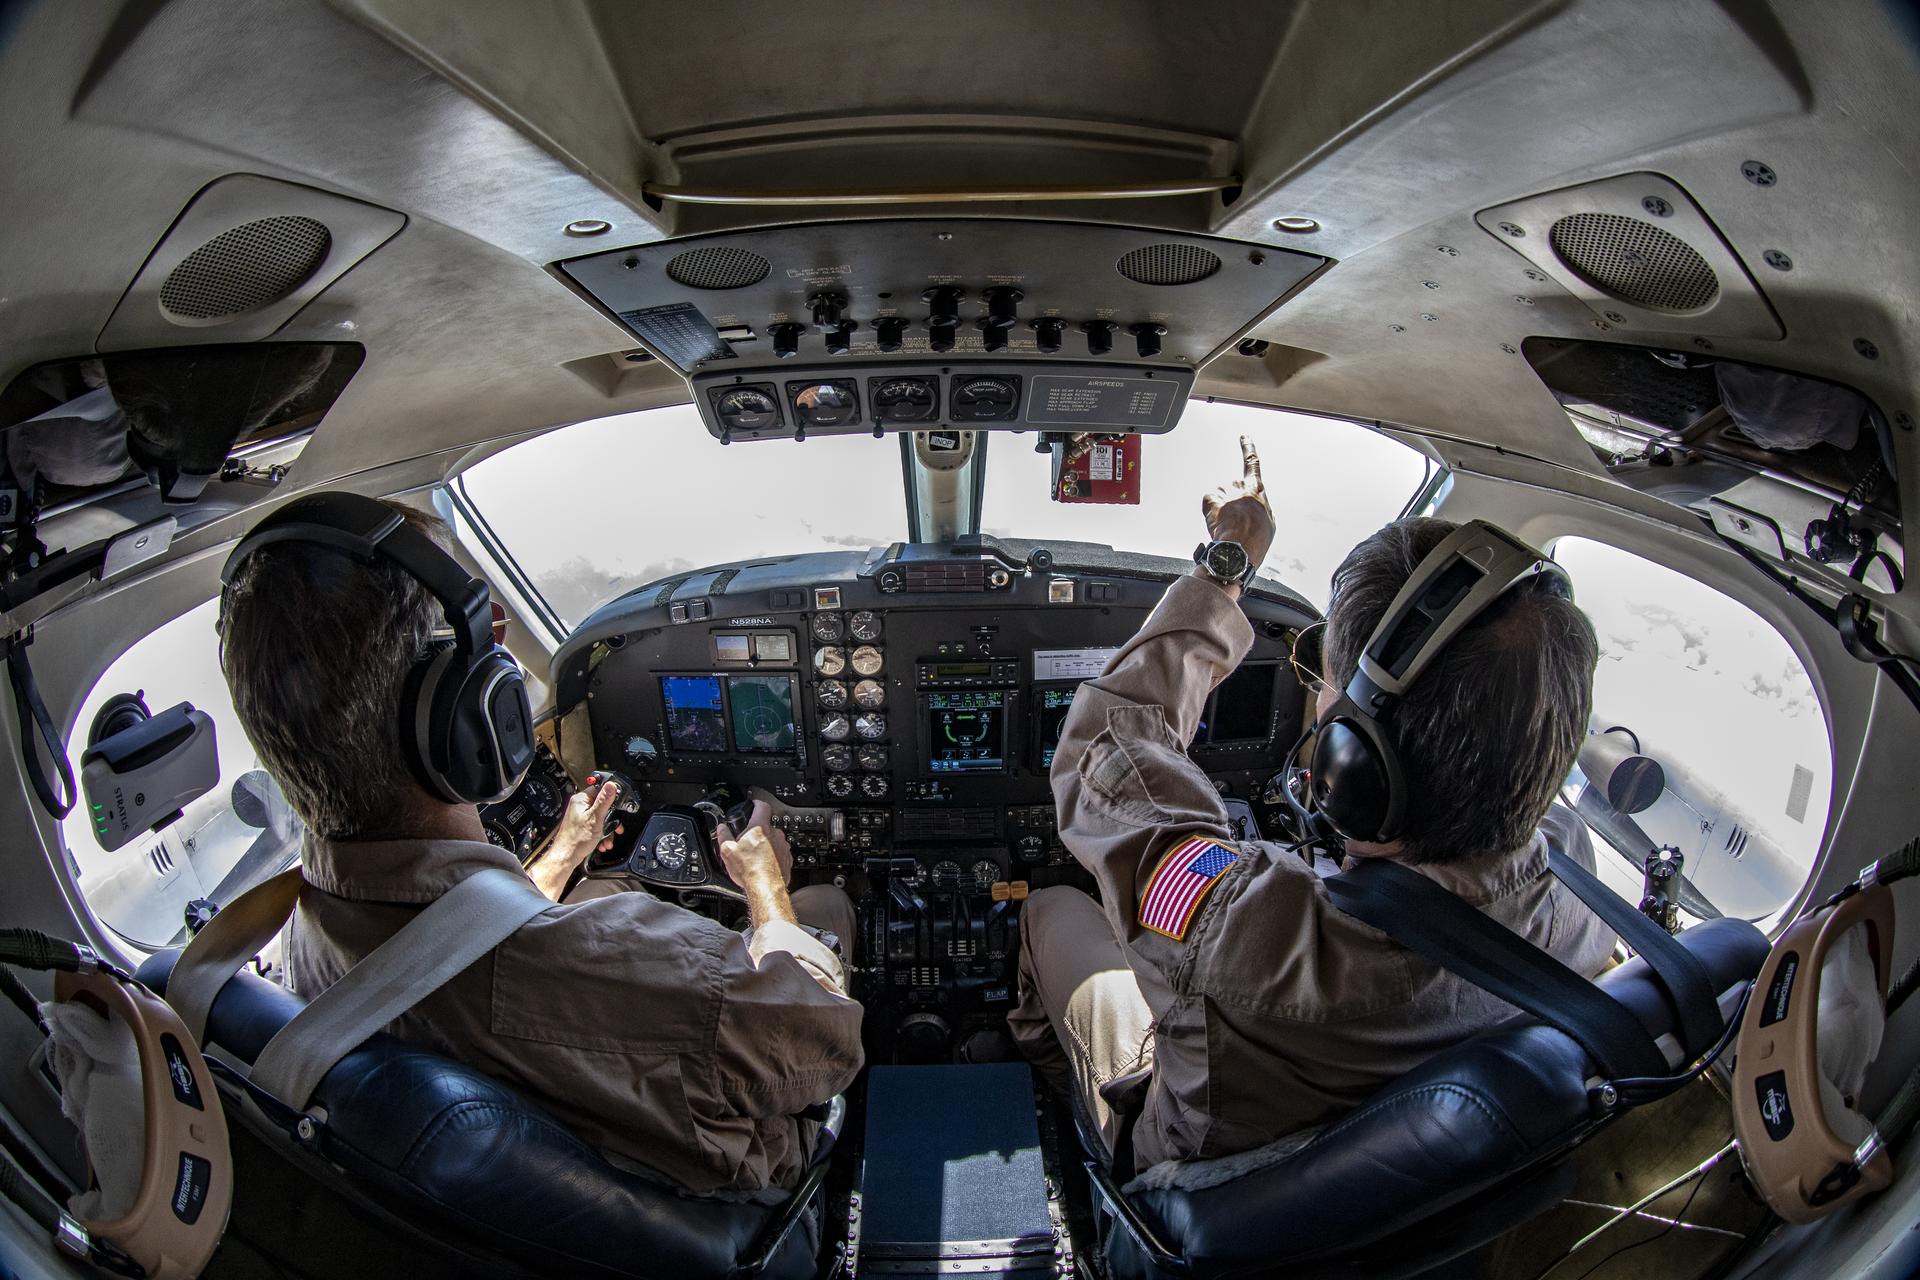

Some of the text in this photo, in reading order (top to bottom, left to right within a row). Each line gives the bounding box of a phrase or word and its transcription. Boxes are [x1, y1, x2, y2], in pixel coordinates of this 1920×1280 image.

[934, 437, 952, 447] INOP
[114, 787, 129, 830] STRATUS
[986, 990, 1006, 998] FLAP
[176, 1157, 193, 1212] INTERTECHNIQUE
